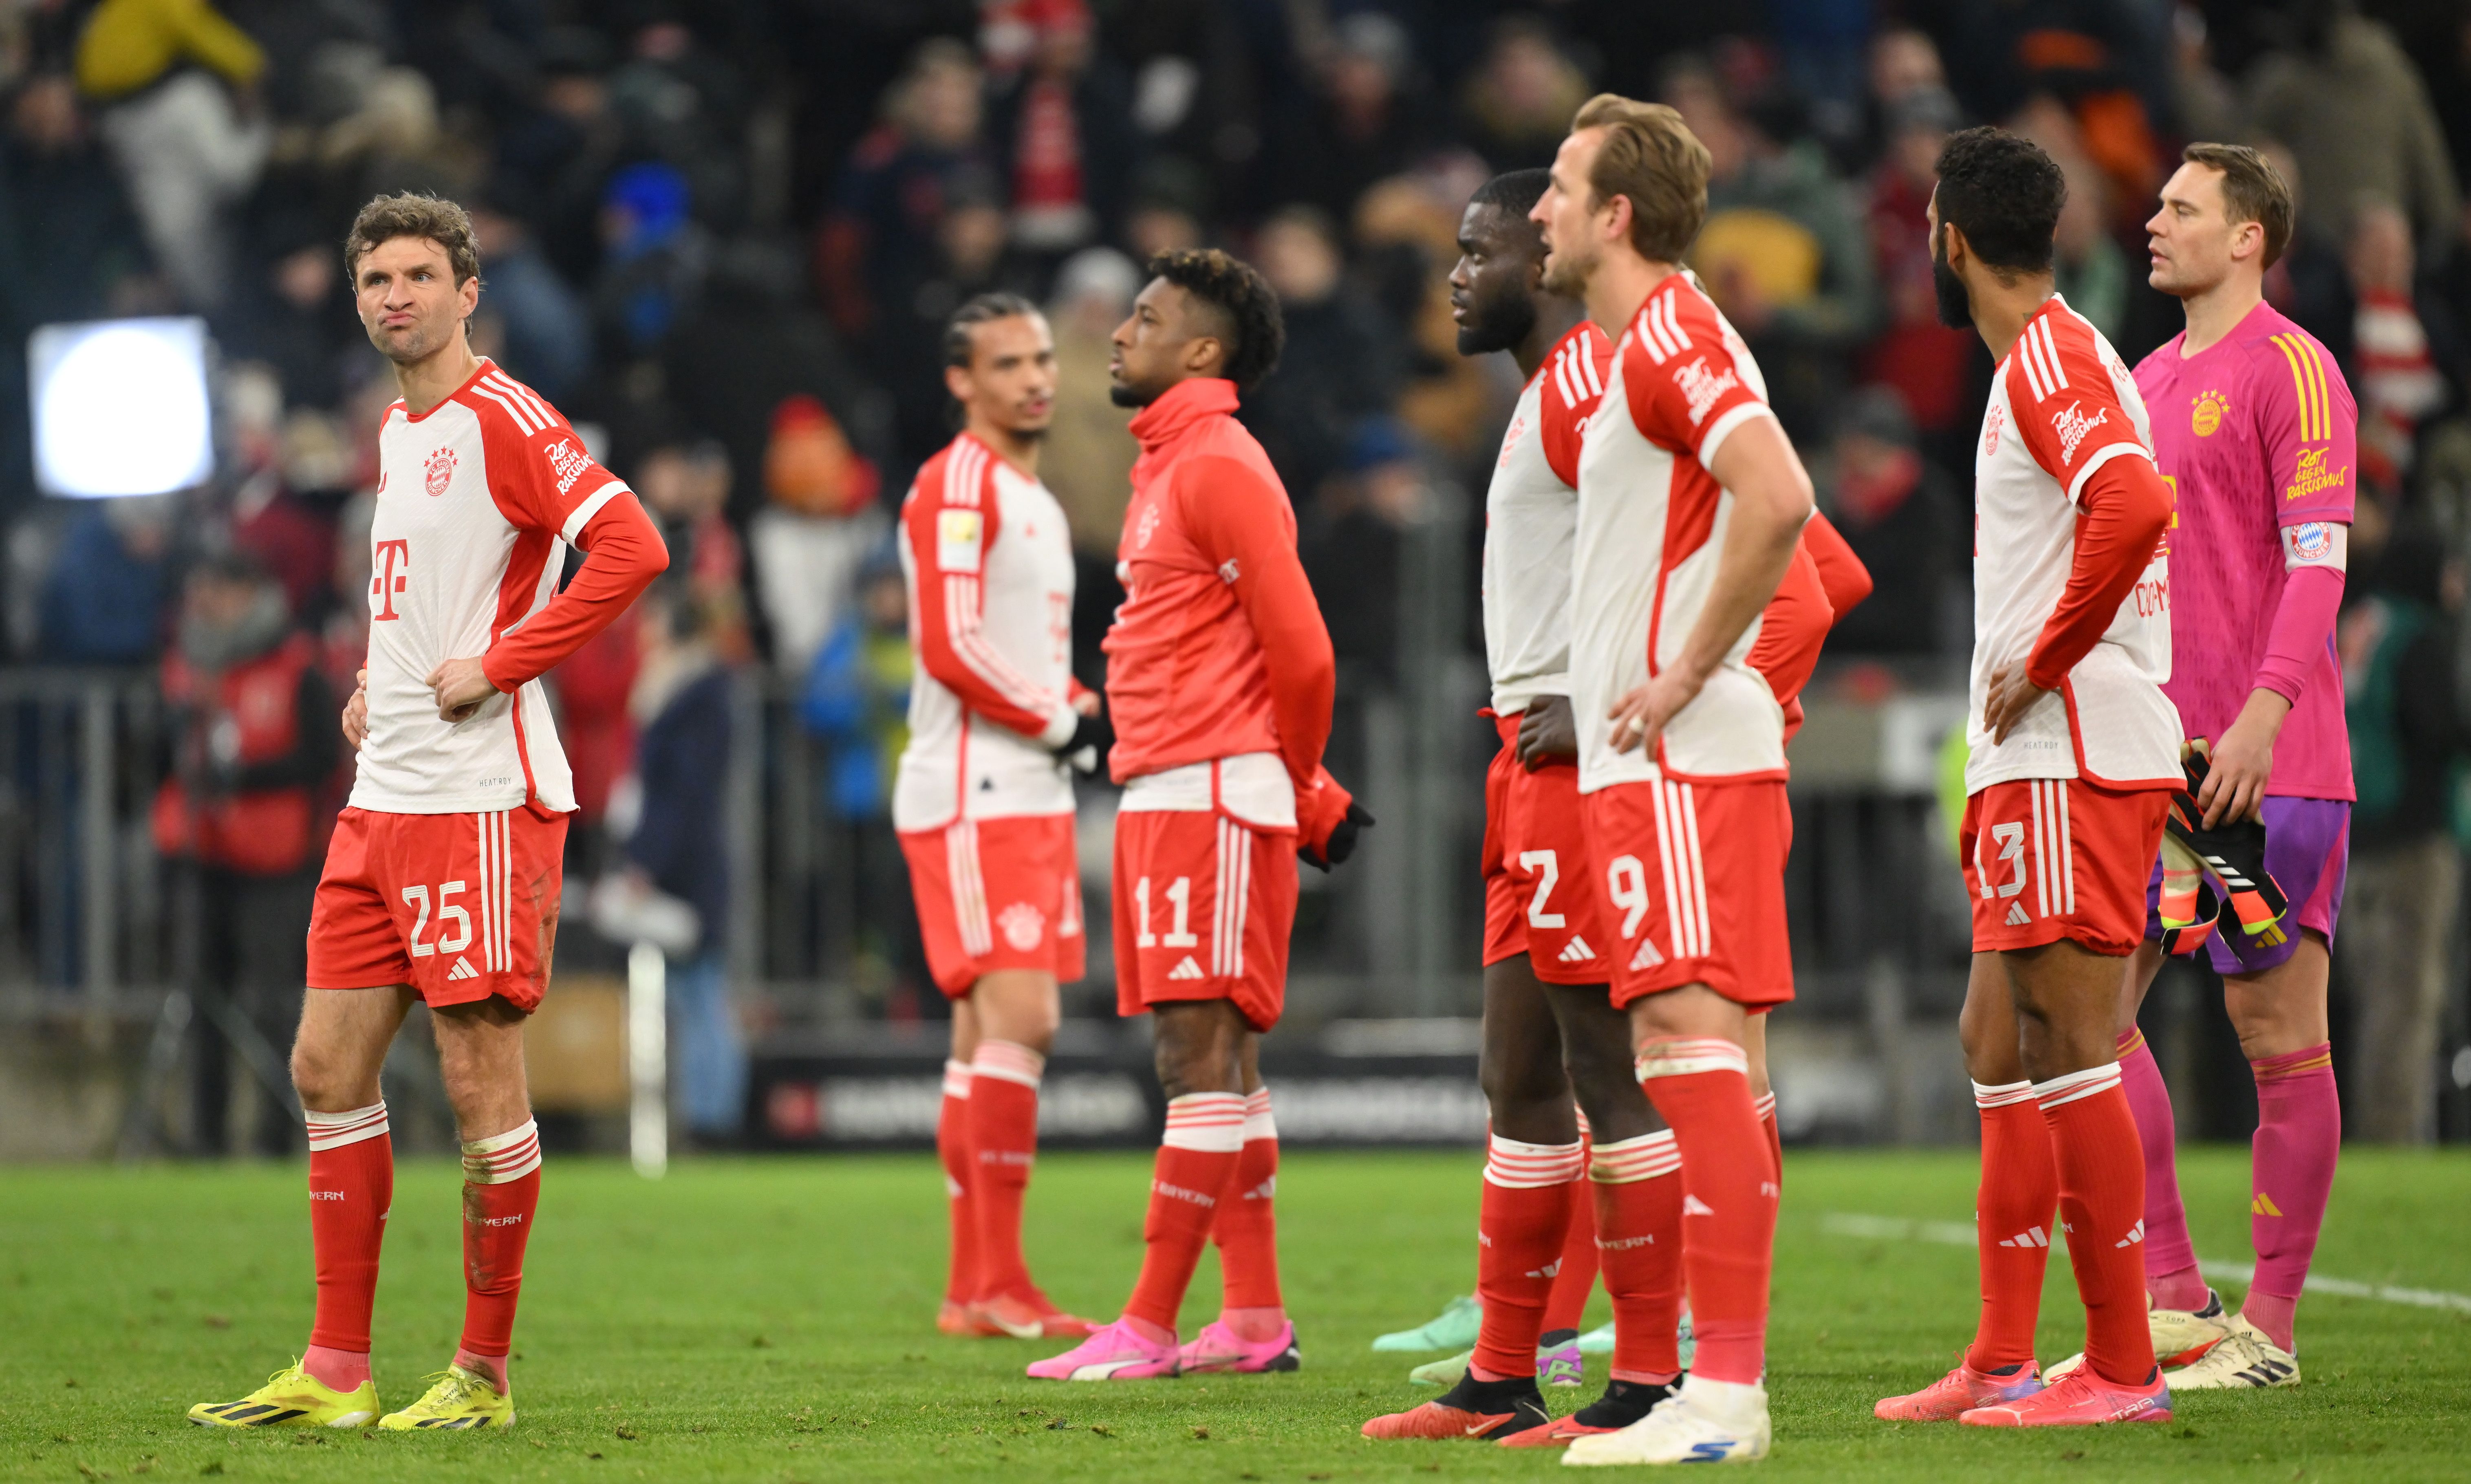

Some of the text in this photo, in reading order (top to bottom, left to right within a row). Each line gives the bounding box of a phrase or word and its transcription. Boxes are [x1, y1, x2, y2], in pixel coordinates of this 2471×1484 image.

[2051, 399, 2081, 435] ROT
[429, 461, 450, 475] FC BAYERN
[544, 438, 570, 466] ROT
[555, 447, 580, 476] GEGEN
[2296, 447, 2330, 471] ROT
[2287, 465, 2348, 501] RASSISMUS
[2295, 457, 2327, 483] GEGEN
[479, 777, 511, 787] HEAT.RDY
[1973, 821, 2026, 900] 13
[1519, 849, 1566, 929] 2
[1607, 854, 1650, 940] 9
[402, 880, 472, 958] 25
[1135, 876, 1198, 948] 11
[2109, 1397, 2155, 1420] TRA
